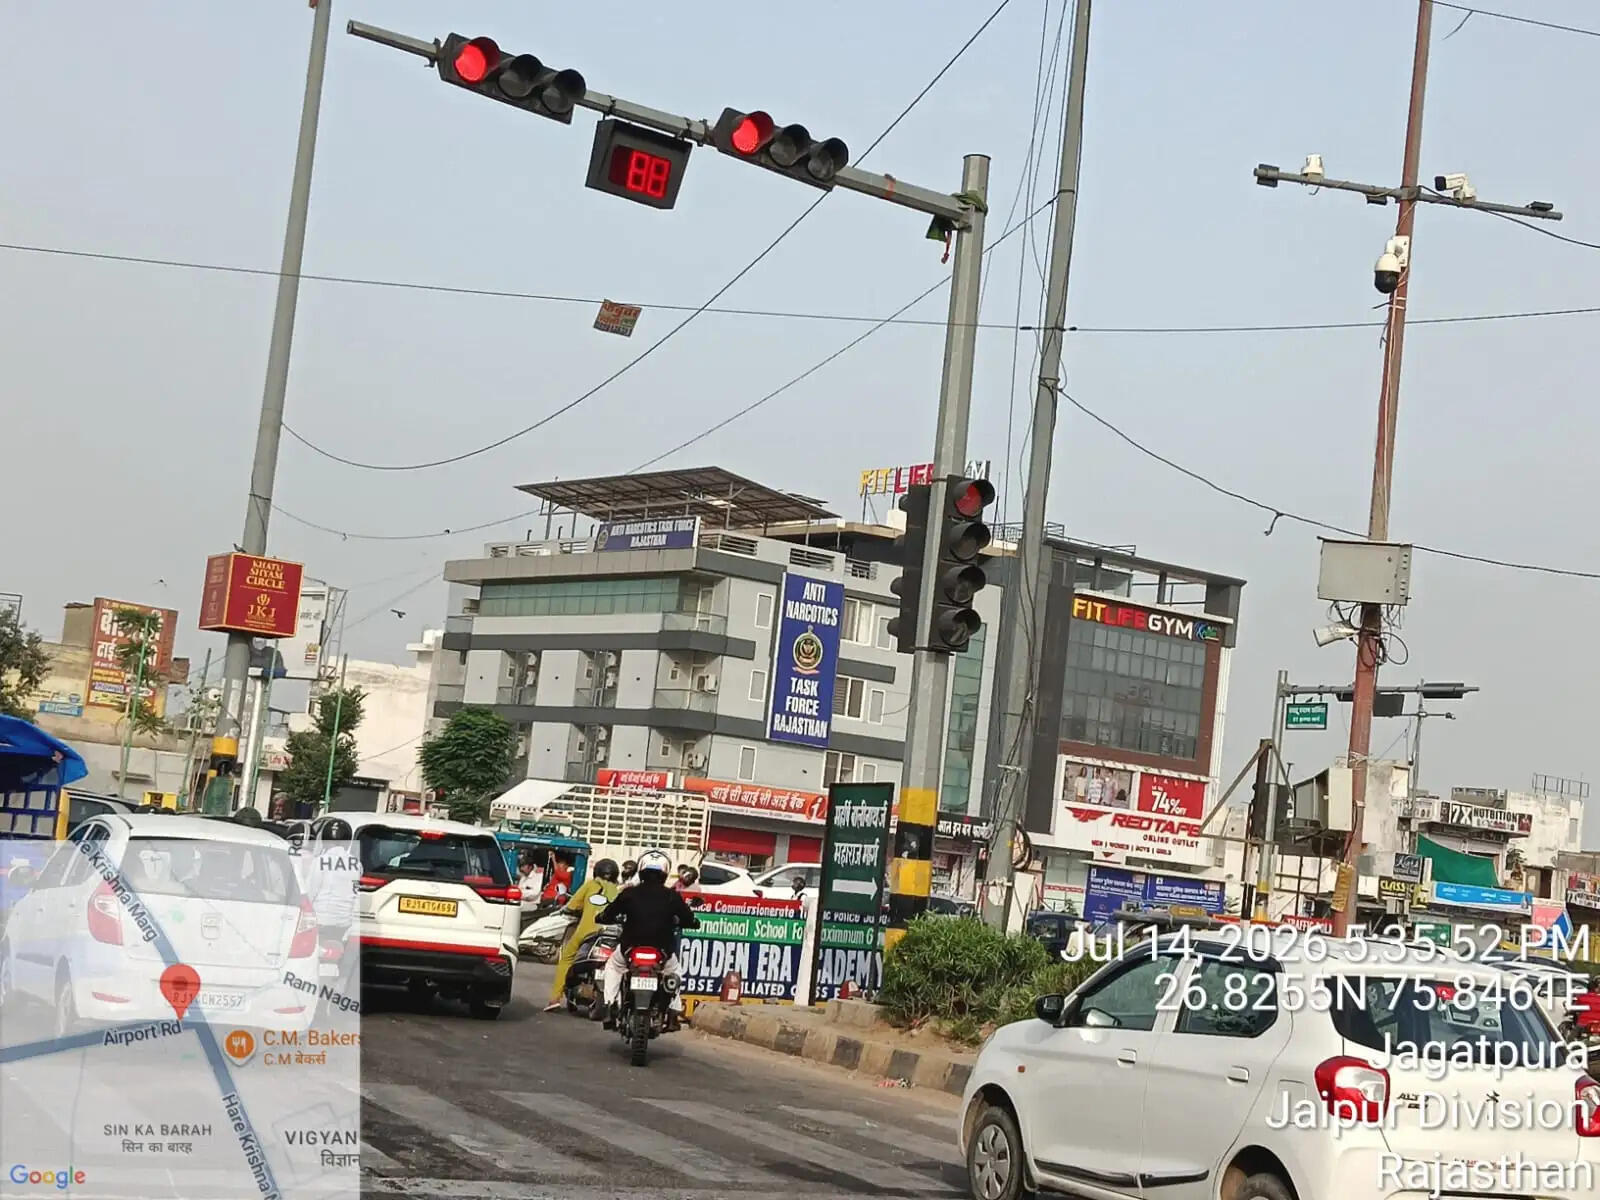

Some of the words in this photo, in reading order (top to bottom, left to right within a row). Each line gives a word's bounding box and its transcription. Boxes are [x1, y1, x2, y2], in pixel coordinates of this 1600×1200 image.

[860, 467, 892, 496] FIT
[249, 567, 284, 580] SHYAM
[253, 560, 284, 571] KHATU
[246, 576, 285, 589] CIRCLE
[802, 581, 826, 603] ANTI
[785, 599, 838, 627] NARCOTICS
[1148, 614, 1194, 640] GYM
[790, 676, 819, 697] TASK
[785, 695, 819, 717] FORCE
[773, 713, 828, 739] RAJASTHAN
[1451, 803, 1472, 825] 7X
[1111, 813, 1201, 838] REDTAPE
[1172, 838, 1199, 848] OUTLET
[714, 900, 795, 919] Commissionerate
[753, 920, 788, 940] School
[680, 937, 751, 978] GOLDEN
[756, 943, 793, 982] ERA
